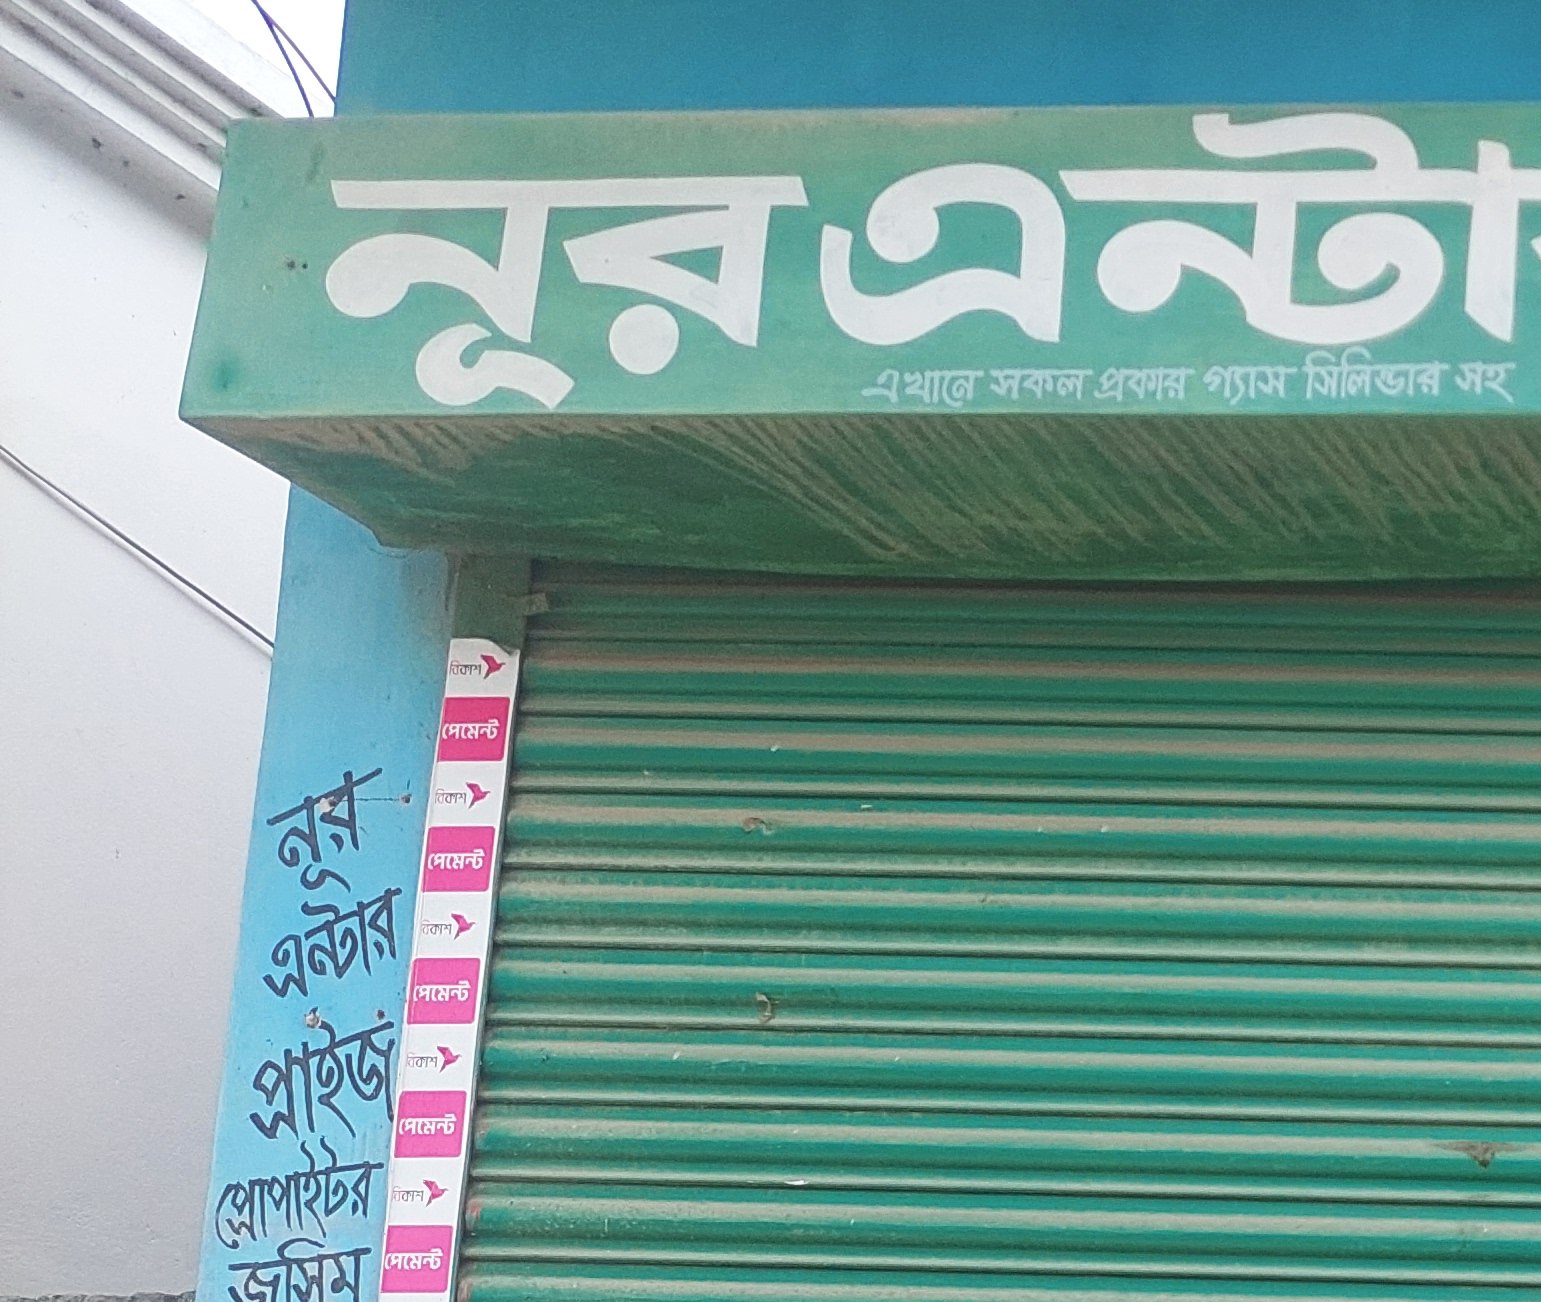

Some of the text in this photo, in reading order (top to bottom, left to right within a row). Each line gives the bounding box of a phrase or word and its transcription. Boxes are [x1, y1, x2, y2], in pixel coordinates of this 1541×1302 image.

[325, 175, 809, 410] নূর
[862, 367, 984, 408] এখানে
[990, 367, 1093, 400] সকল
[1094, 366, 1196, 402] প্রকার
[1202, 363, 1298, 407] গ্যাস
[1454, 360, 1517, 404] সহ
[442, 719, 499, 740] পেমেন্ট
[267, 768, 383, 893] নূর
[428, 849, 485, 870] পেমেন্ট
[263, 887, 402, 999] এন্টার
[413, 980, 470, 1001] পেমেন্ট
[248, 1019, 397, 1141] প্রাইজ
[399, 1114, 457, 1135] পেমেন্ট
[385, 1249, 442, 1270] পেমেন্ট
